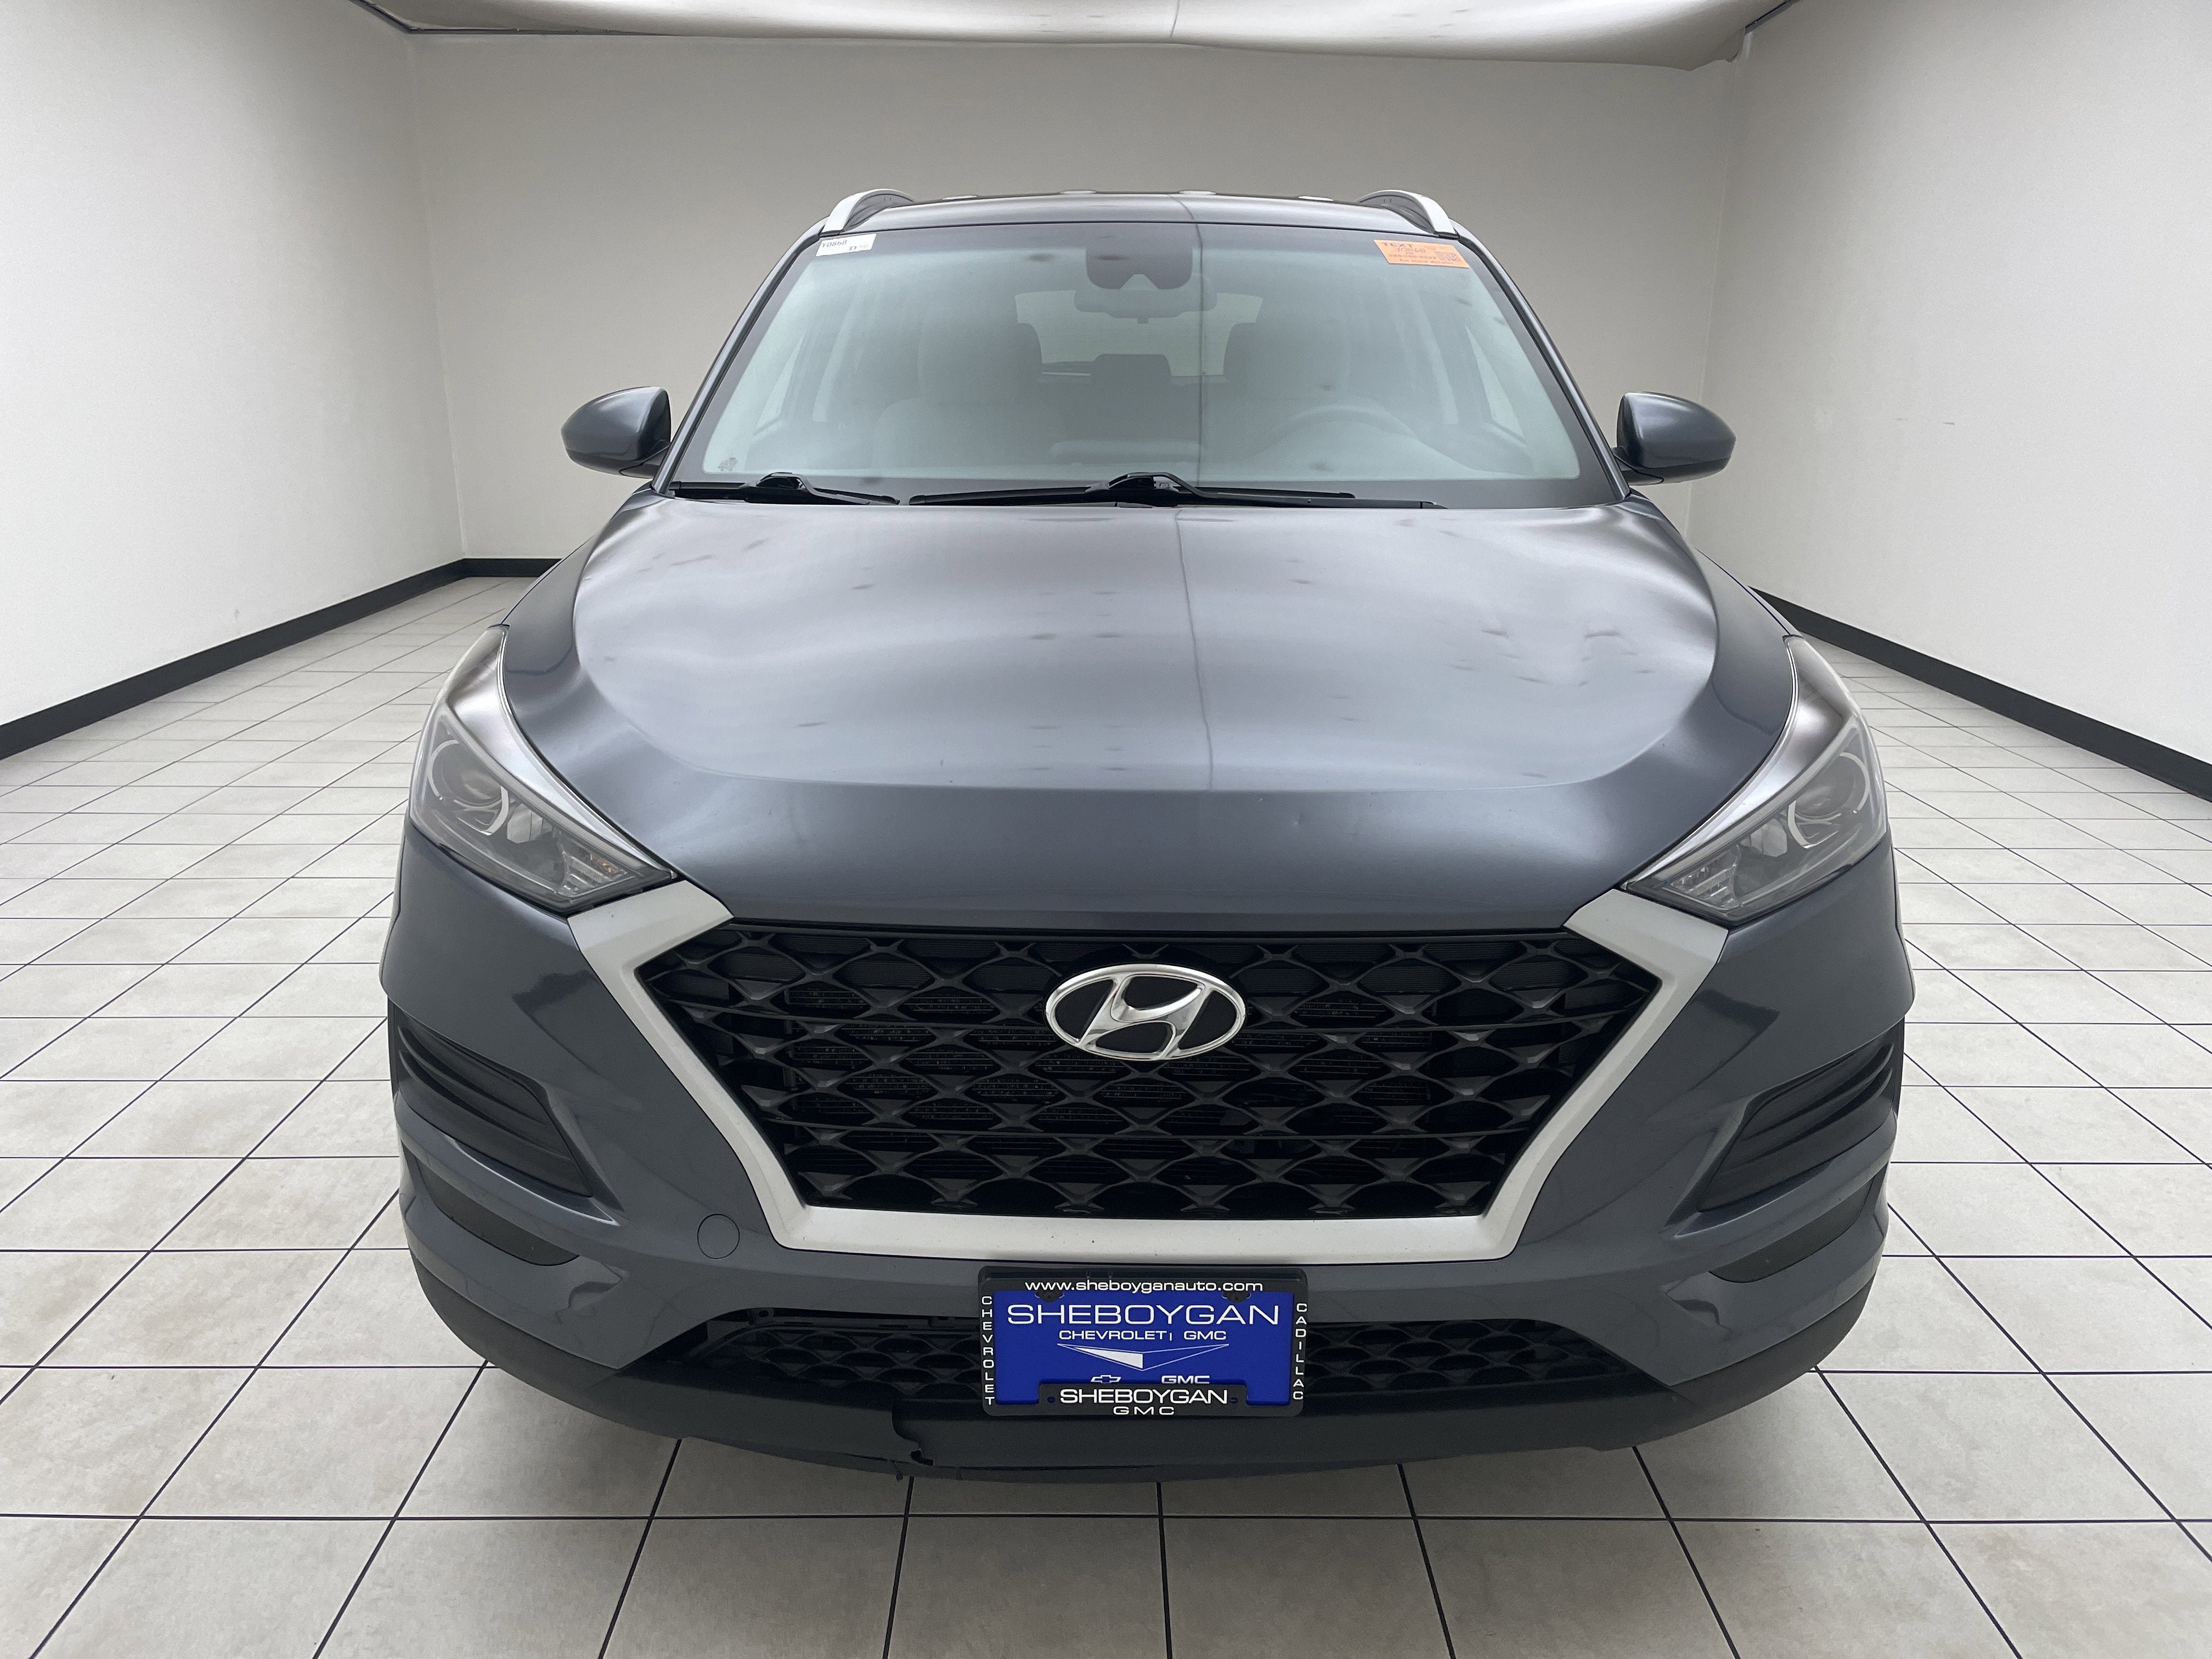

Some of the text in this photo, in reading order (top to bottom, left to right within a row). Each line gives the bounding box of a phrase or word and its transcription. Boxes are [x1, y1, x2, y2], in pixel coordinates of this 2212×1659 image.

[1025, 1279, 1263, 1294] www.sheboyganauto.com
[1007, 1304, 1279, 1325] SHEBOYGAN
[1058, 1330, 1227, 1340] CHEVROLET GMC
[981, 1295, 995, 1406] CHEVROLET
[1292, 1302, 1308, 1400] CADILLAC
[1161, 1375, 1210, 1385] GMC
[1059, 1388, 1228, 1404] SHEBOYGAN
[1113, 1406, 1175, 1416] GMC
